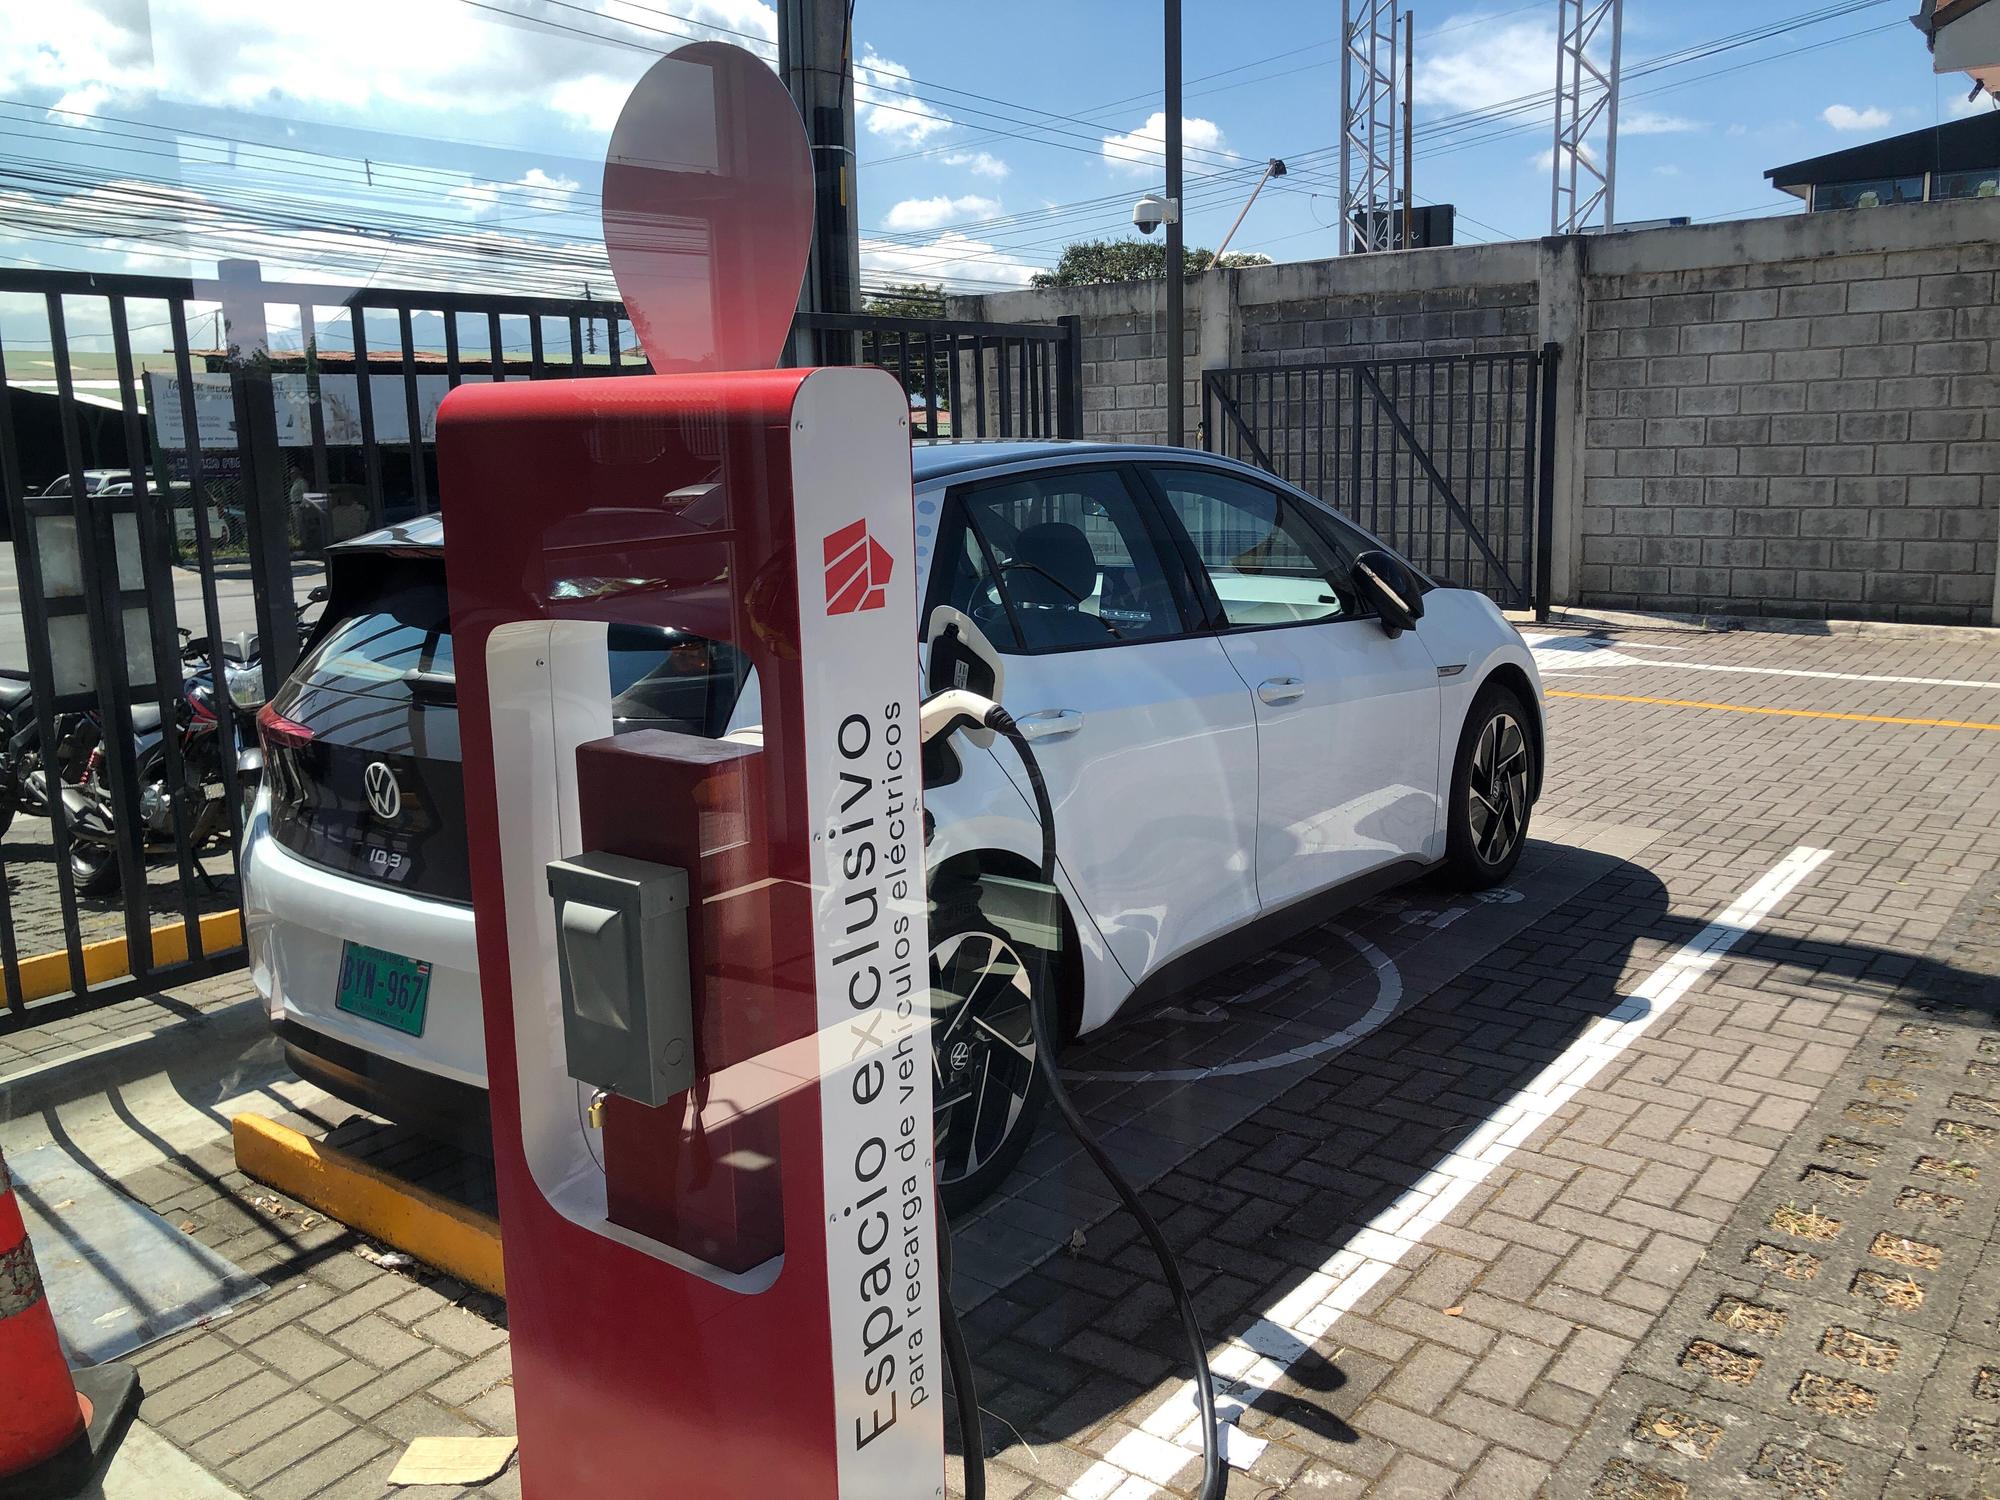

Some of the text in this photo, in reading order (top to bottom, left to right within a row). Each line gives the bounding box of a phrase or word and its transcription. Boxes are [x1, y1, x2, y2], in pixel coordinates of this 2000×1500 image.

[342, 955, 424, 1014] BYN-967
[828, 714, 903, 1451] Espacio exclusivo
[882, 701, 929, 1410] para recarga de vehículos eléctricos
